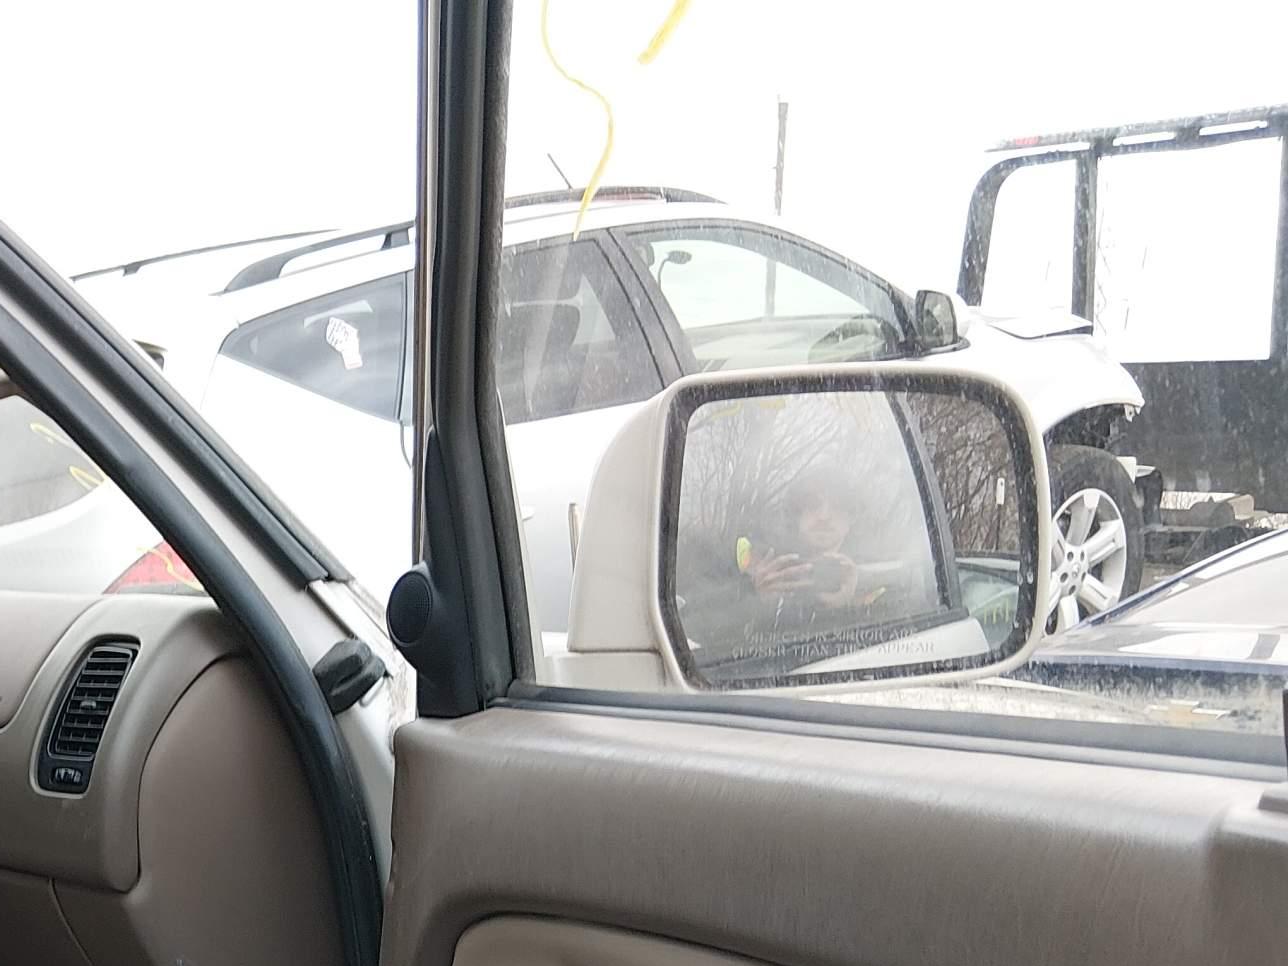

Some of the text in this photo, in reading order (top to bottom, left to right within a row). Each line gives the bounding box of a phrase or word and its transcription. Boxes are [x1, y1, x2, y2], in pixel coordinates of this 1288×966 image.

[815, 630, 827, 642] IN
[831, 629, 884, 643] MIRROR
[731, 646, 787, 659] CLOSER
[792, 644, 832, 657] THAN
[877, 641, 937, 655] APPEAR
